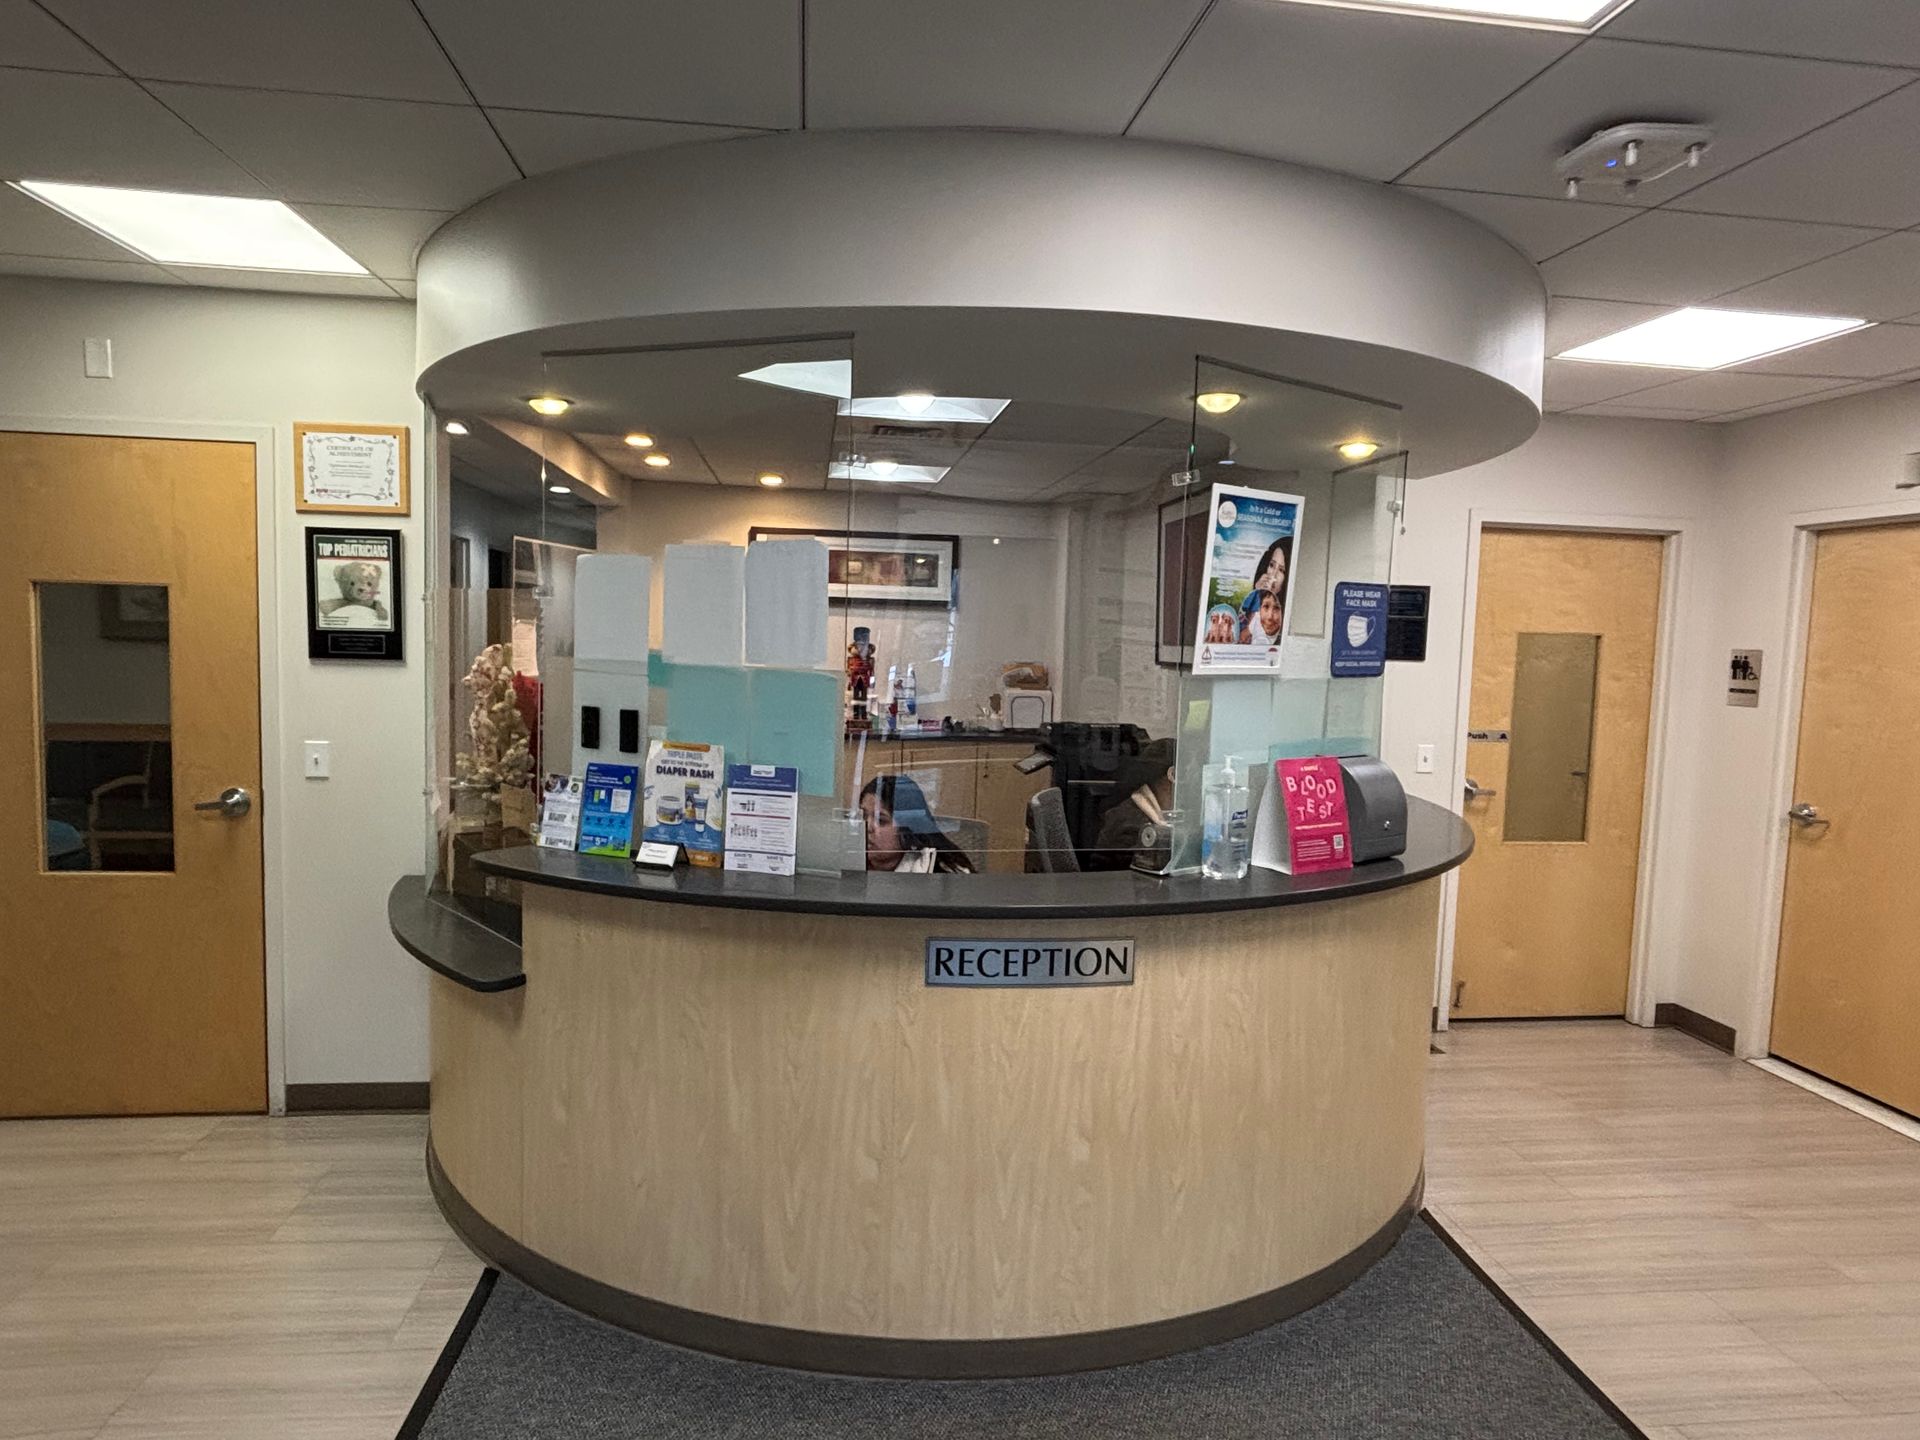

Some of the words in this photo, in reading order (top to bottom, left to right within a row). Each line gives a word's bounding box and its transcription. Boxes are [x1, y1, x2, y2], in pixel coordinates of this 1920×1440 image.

[318, 543, 333, 556] TOP
[334, 543, 388, 557] PEDIATRICIANS
[1343, 589, 1364, 598] PLEASE
[1345, 599, 1361, 607] FACE
[656, 765, 688, 777] DIAPER
[690, 768, 715, 779] RASH
[1286, 775, 1336, 799] BLOOD
[1297, 798, 1334, 821] TEST
[935, 946, 1128, 978] RECEPTION
